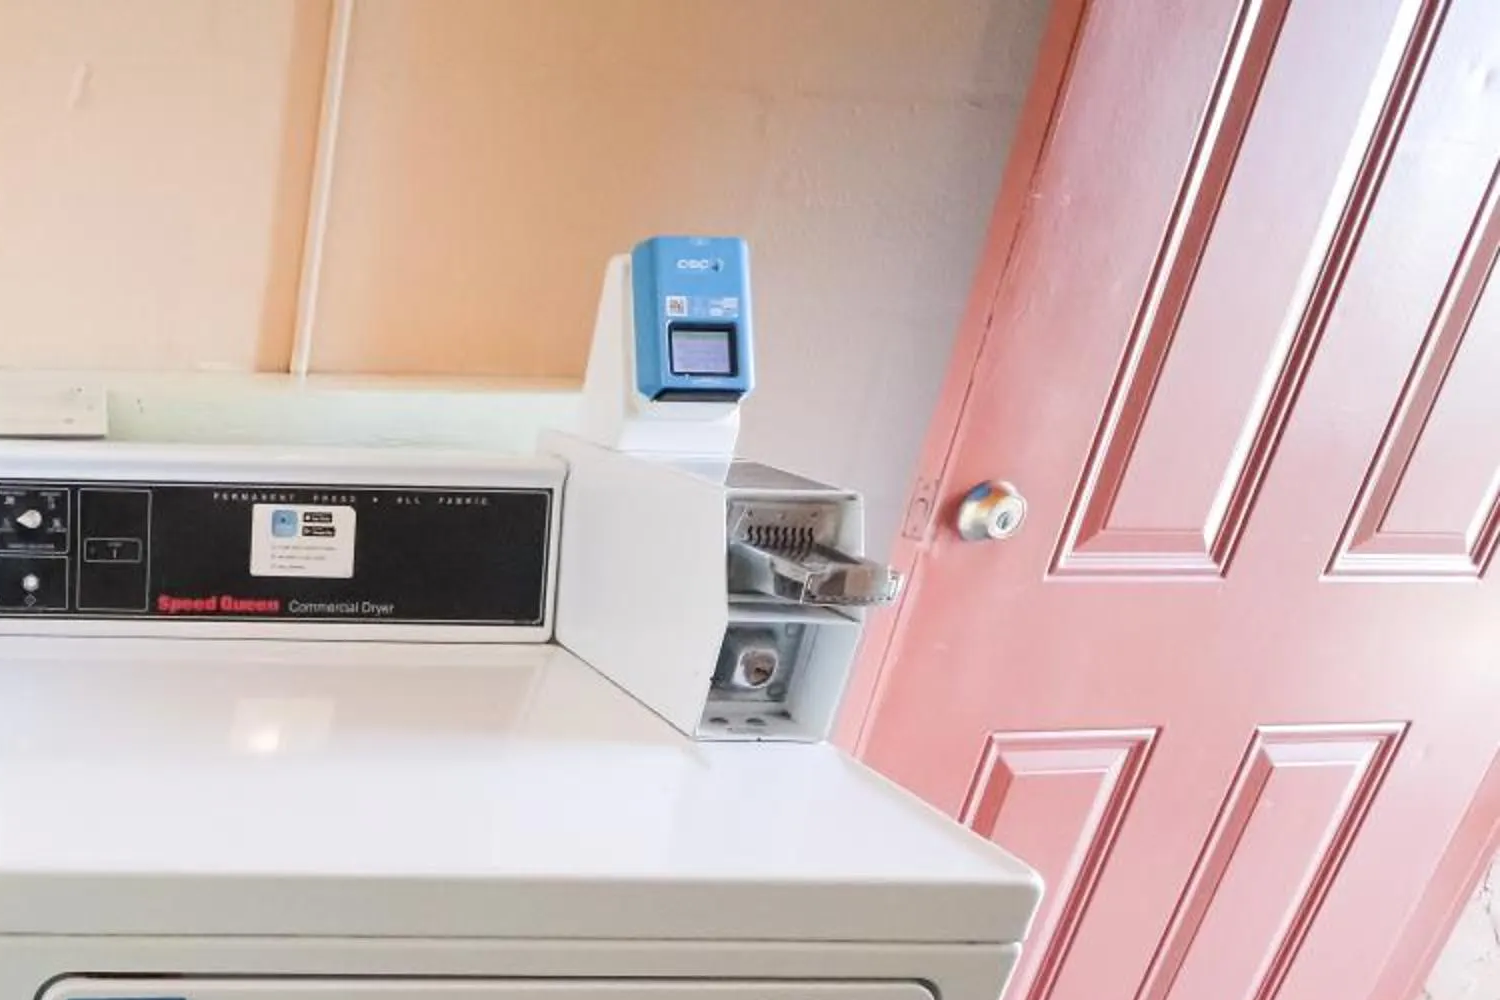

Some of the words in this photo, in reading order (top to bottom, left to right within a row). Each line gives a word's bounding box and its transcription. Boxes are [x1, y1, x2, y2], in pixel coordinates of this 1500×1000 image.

[158, 594, 217, 614] Speed
[220, 594, 281, 612] Queen
[288, 600, 359, 614] Commercial
[361, 601, 395, 616] Dryer
